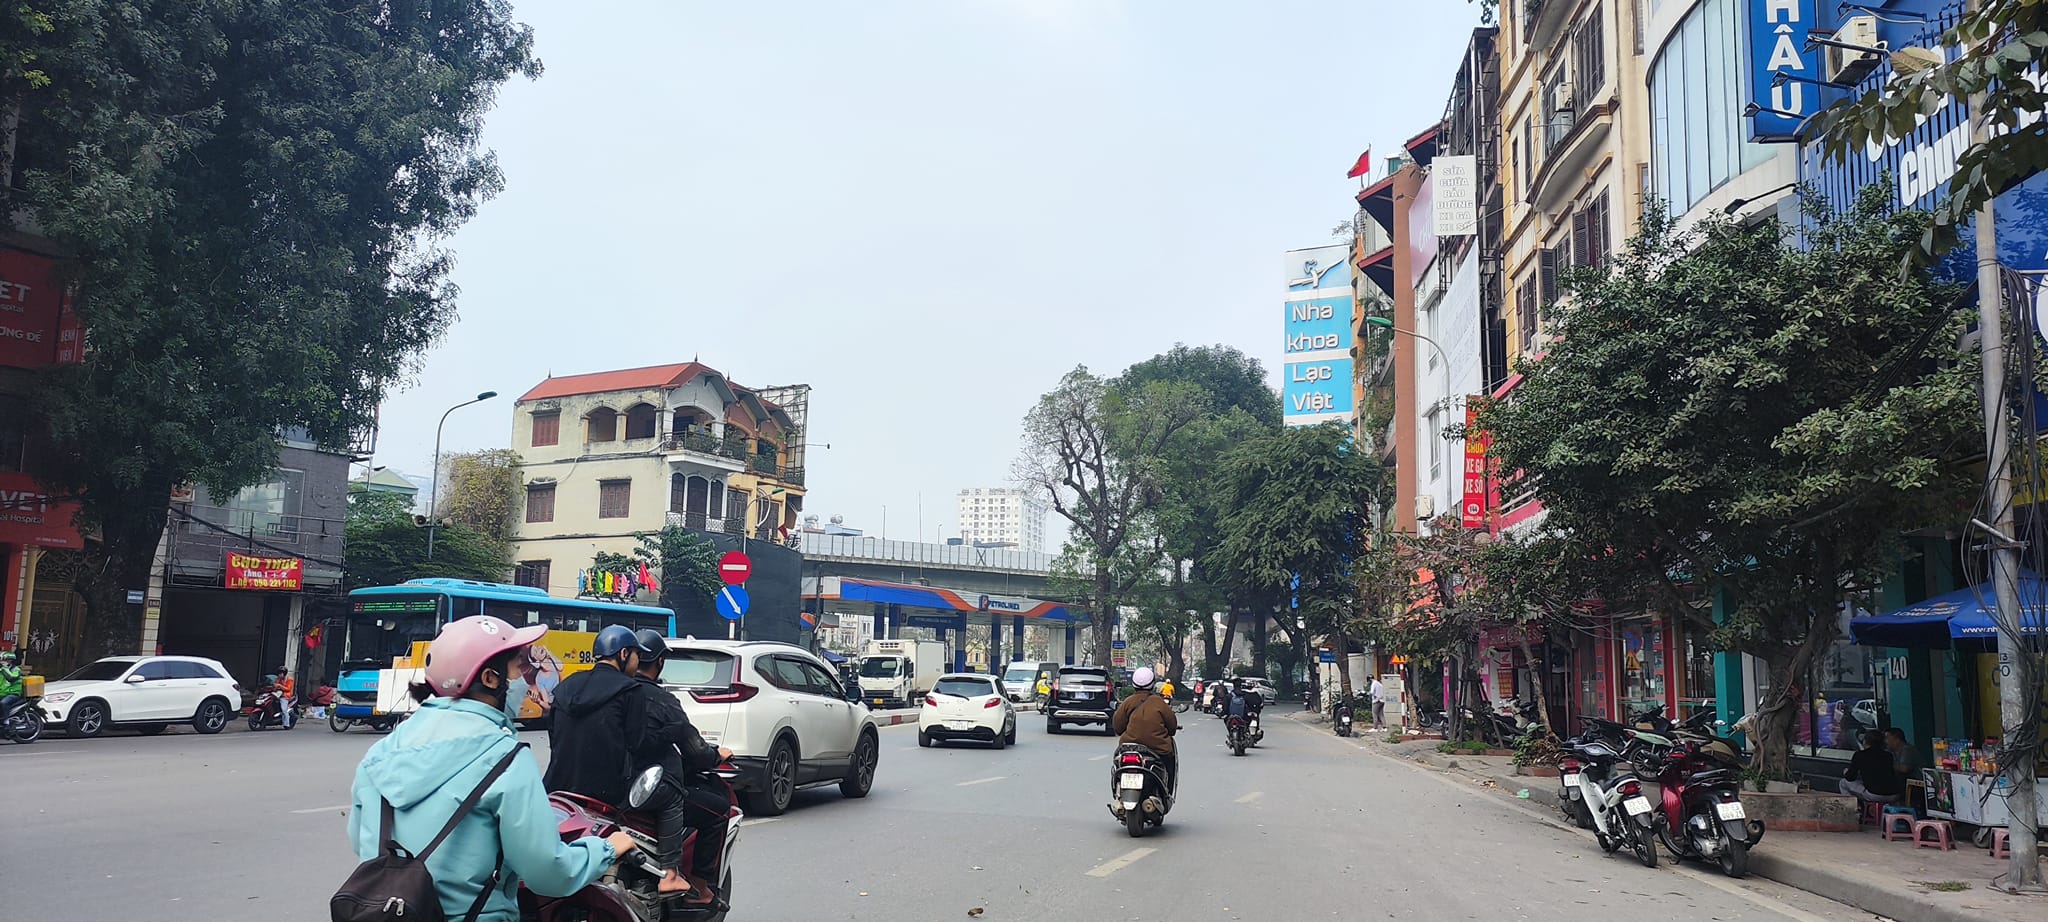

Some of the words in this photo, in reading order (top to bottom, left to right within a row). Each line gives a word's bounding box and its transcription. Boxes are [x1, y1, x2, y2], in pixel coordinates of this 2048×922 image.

[1292, 303, 1333, 322] Nha
[1287, 332, 1339, 352] khoa
[1292, 364, 1332, 384] Lạc
[1292, 391, 1334, 413] Việt
[1466, 458, 1475, 473] XE
[1465, 478, 1474, 494] XE
[231, 555, 260, 569] CHO
[1887, 656, 1908, 680] 140
